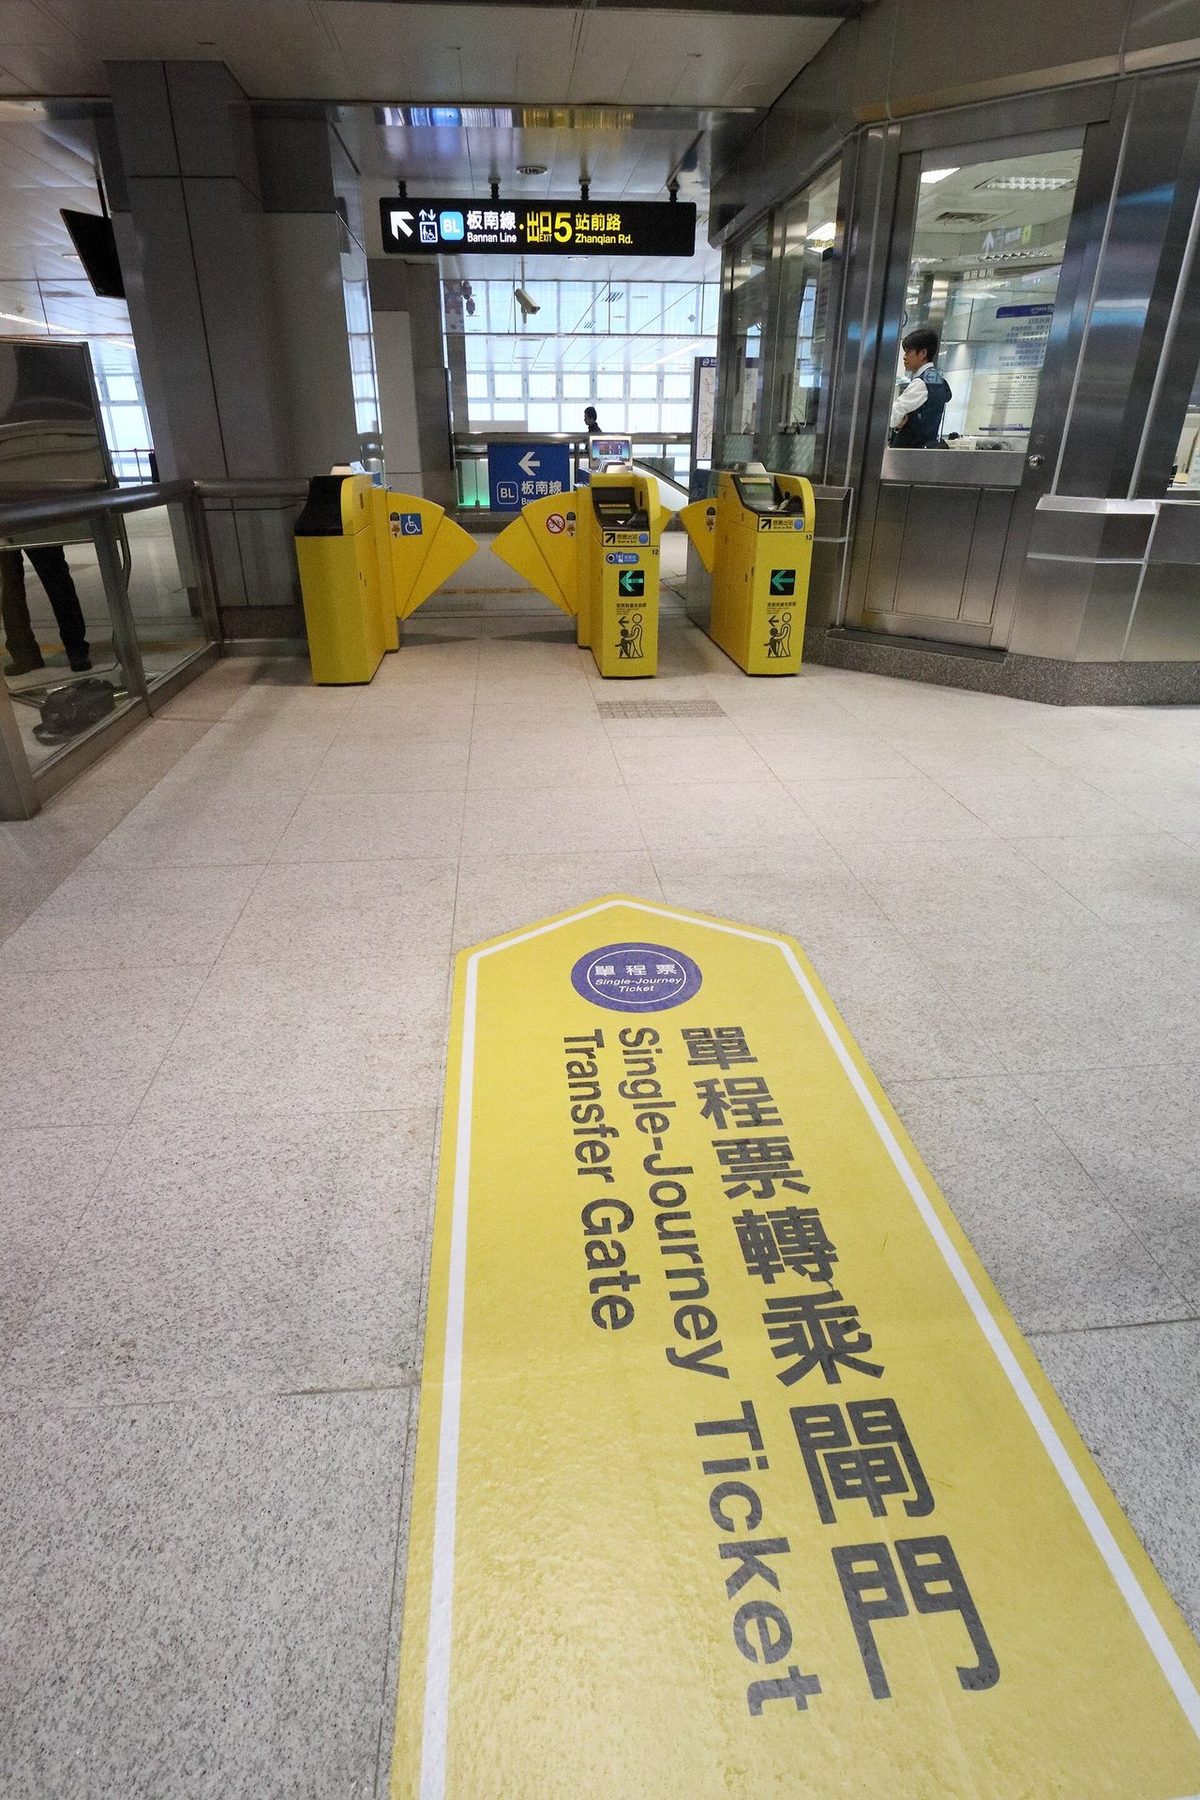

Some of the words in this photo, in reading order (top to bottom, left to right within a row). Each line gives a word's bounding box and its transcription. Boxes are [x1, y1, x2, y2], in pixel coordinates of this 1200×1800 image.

[443, 218, 460, 233] BL
[467, 210, 517, 230] 板南線
[553, 212, 573, 243] 5
[575, 212, 622, 231] 站前路
[467, 232, 498, 243] Bannan
[499, 232, 517, 243] Line
[540, 234, 552, 242] EXIT
[575, 233, 616, 245] Zhanqian
[618, 234, 633, 244] Rd.
[500, 488, 515, 498] BL
[521, 480, 562, 495] 板南線
[595, 964, 677, 976] 單程票
[595, 977, 682, 986] Single-Journey
[619, 985, 655, 993] Ticket
[562, 1028, 620, 1185] Transfer
[581, 1198, 642, 1331] Gate
[680, 1026, 1001, 1701] 單程票轉乘閘門
[617, 1027, 732, 1380] Single-Journey
[694, 1399, 823, 1716] Ticket
